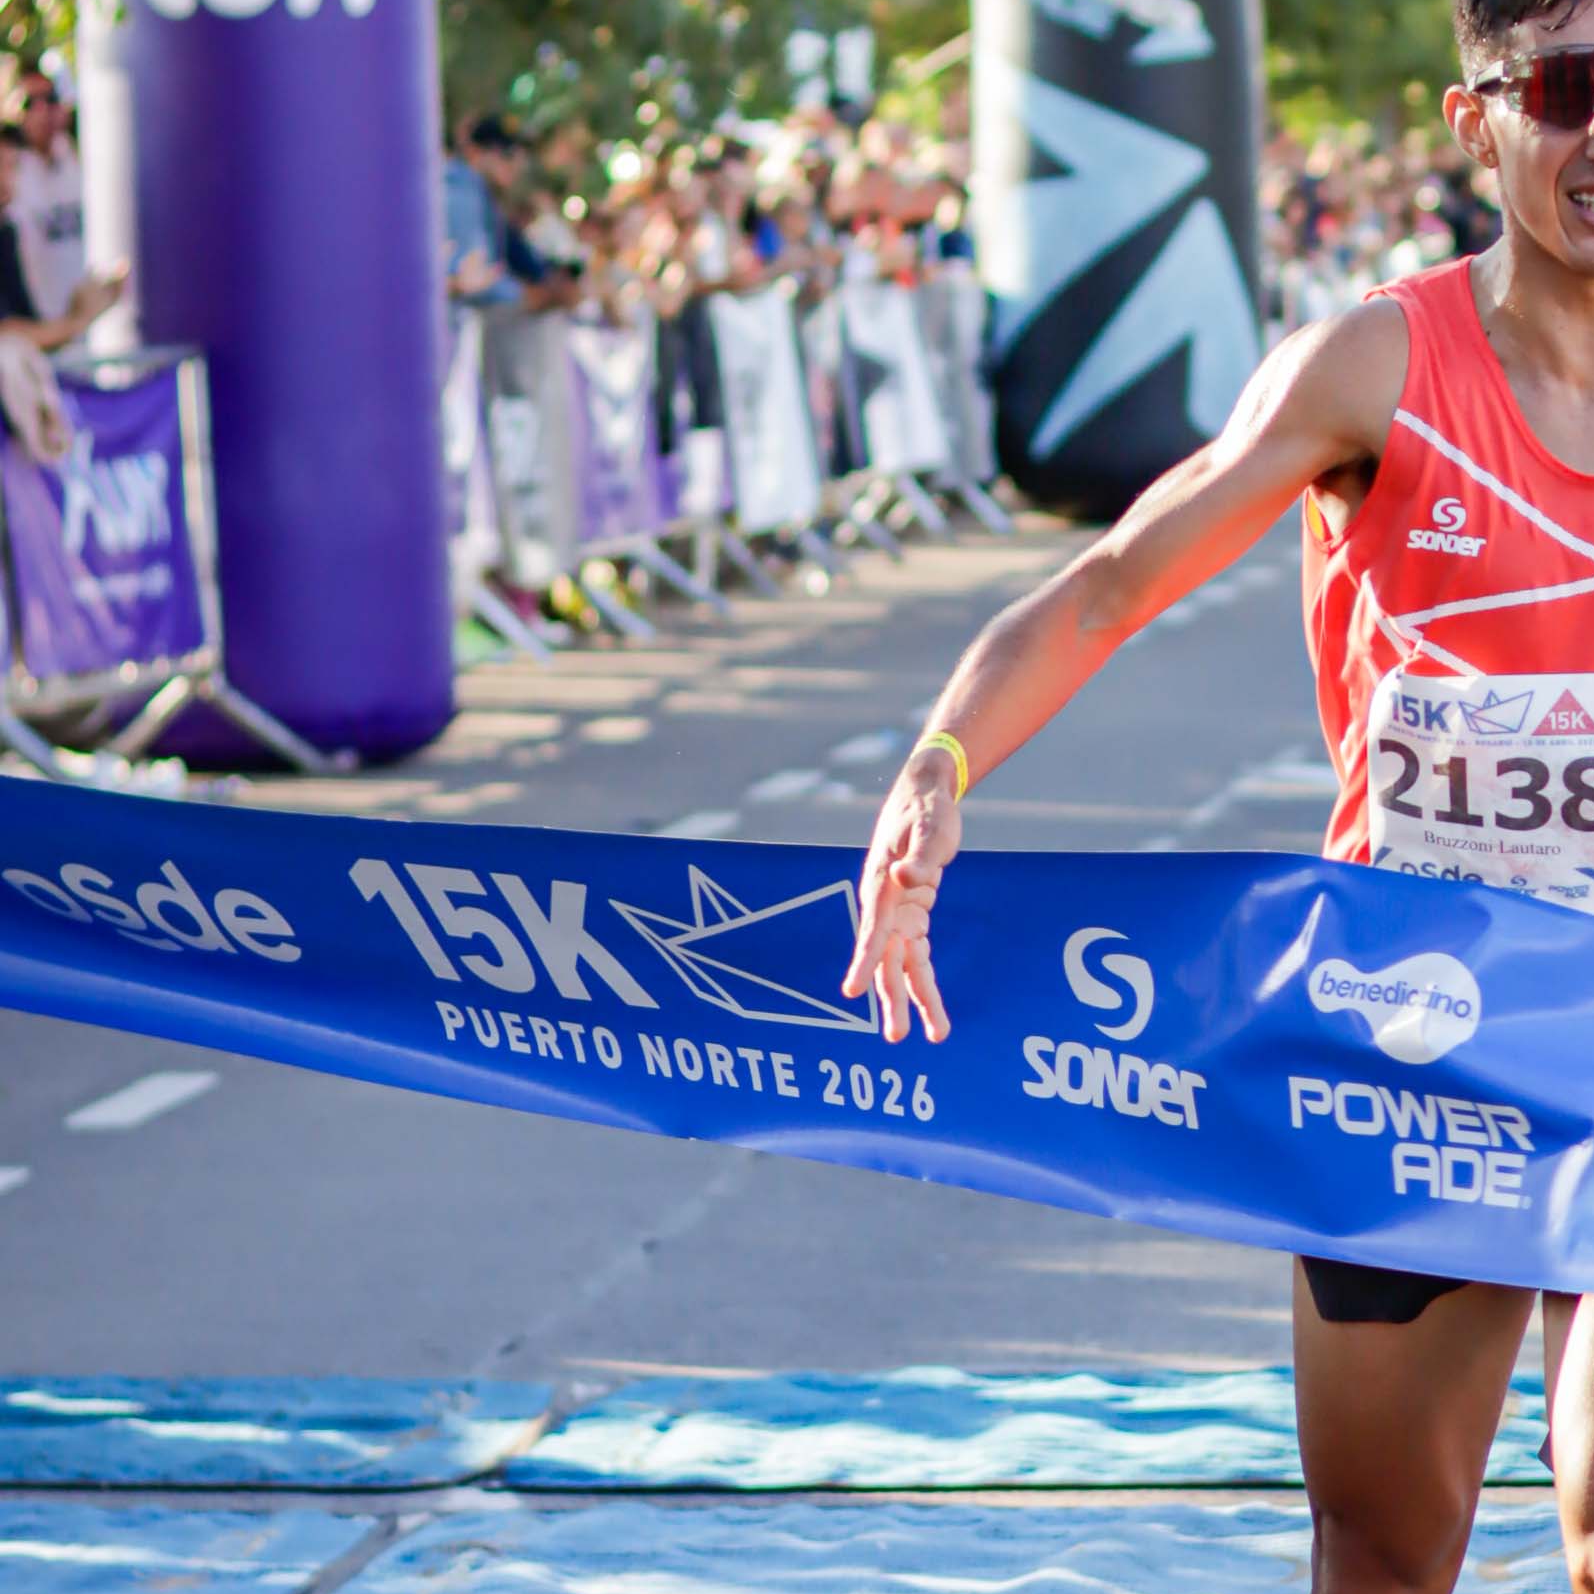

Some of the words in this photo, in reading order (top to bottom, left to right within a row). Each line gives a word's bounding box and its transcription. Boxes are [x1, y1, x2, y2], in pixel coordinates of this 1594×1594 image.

[1548, 710, 1587, 731] 15K
[1423, 829, 1493, 854] Bruzzoni
[1499, 840, 1562, 856] Lautaro
[2, 858, 302, 964] osde
[349, 857, 660, 1010] 15K
[434, 1001, 623, 1071] PUERTO
[641, 1033, 801, 1099] NORTE
[822, 1059, 935, 1123] 2026
[1288, 1076, 1536, 1153] POWER
[1391, 1142, 1529, 1210] ADE
